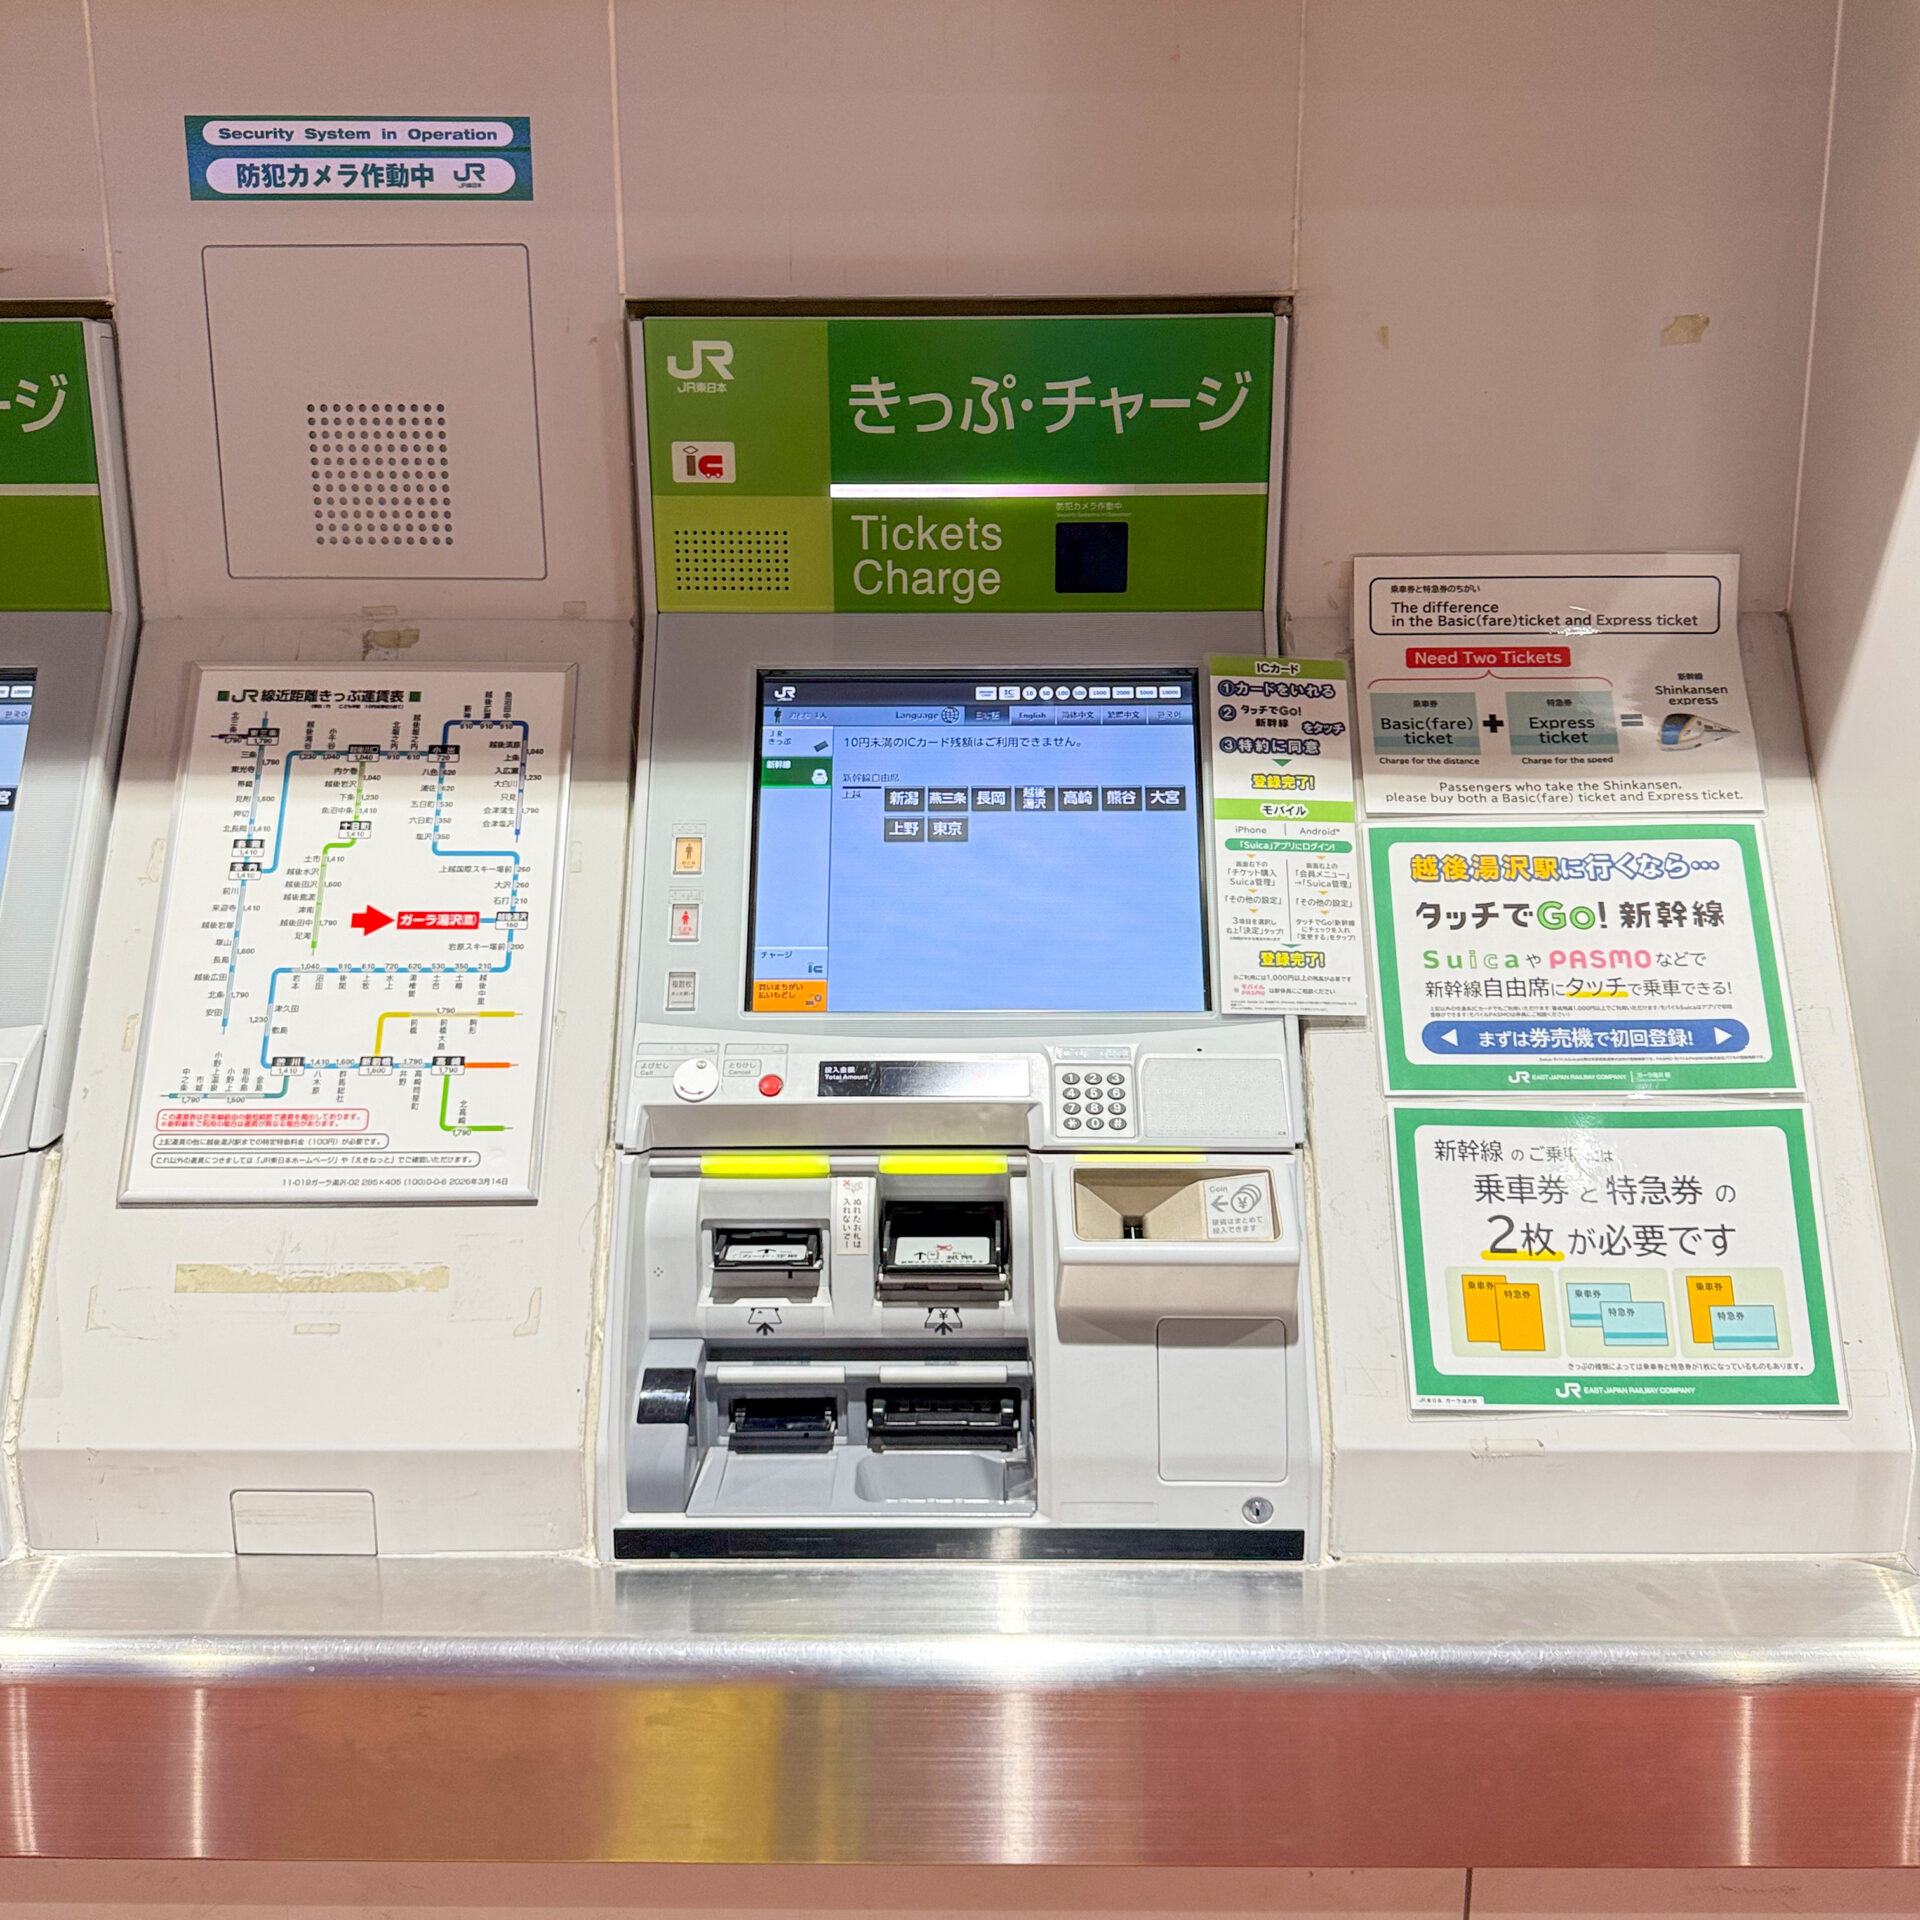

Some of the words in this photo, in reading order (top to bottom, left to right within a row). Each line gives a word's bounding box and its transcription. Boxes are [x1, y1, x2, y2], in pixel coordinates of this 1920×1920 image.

[218, 127, 294, 142] Security
[304, 127, 371, 142] System
[381, 128, 397, 141] in
[407, 127, 498, 142] Operation
[236, 162, 434, 189] 防犯カメラ作動中
[453, 163, 486, 182] JR
[667, 340, 735, 380] JR
[677, 380, 728, 393] JR東日本
[0, 373, 68, 433] ジ
[848, 371, 1253, 436] きっぷ・チャージ
[851, 515, 1003, 551] Tickets
[852, 559, 1002, 604] Charge
[1390, 584, 1481, 594] 乗車券と特急券のちがい
[1391, 602, 1418, 614] The
[1423, 601, 1499, 614] difference
[1391, 615, 1405, 627] in
[1409, 615, 1433, 627] the
[1438, 614, 1560, 629] Basic(fare)ticket
[1565, 614, 1592, 627] and
[1596, 615, 1652, 629] Express
[1656, 614, 1698, 627] ticket
[1414, 652, 1458, 665] Need
[1462, 652, 1497, 665] Two
[1501, 651, 1562, 664] Tickets
[1256, 663, 1299, 674] ICカード
[1677, 673, 1703, 681] 新幹線
[231, 689, 404, 703] JR線近距離きっぷ運賃表
[774, 686, 796, 699] JR
[1655, 685, 1728, 695] Shinkansen
[1413, 700, 1438, 708] 乗車券
[1547, 699, 1572, 707] 特急券
[1669, 697, 1718, 707] express
[896, 711, 939, 721] Language
[1255, 718, 1288, 728] 新幹線
[1302, 721, 1346, 735] をタッチ
[1380, 716, 1473, 731] Basic(fare)
[1529, 717, 1595, 730] Express
[768, 738, 792, 746] きっぷ
[845, 736, 1082, 749] 10円未満のICカード残額はご利用できません。
[1404, 731, 1453, 745] ticket
[1539, 731, 1588, 744] ticket
[766, 761, 791, 769] 新幹線
[1379, 757, 1411, 766] Charge
[1412, 757, 1426, 765] for
[1428, 757, 1442, 765] the
[1444, 757, 1480, 765] distance
[1522, 756, 1554, 765] Charge
[1556, 756, 1569, 764] for
[1572, 756, 1585, 764] the
[1587, 756, 1614, 765] speed
[1251, 774, 1315, 790] 登録完了!
[1439, 782, 1512, 793] Passengers
[1515, 782, 1542, 792] who
[1545, 781, 1574, 792] take
[1578, 781, 1599, 791] the
[890, 792, 919, 806] 新潟
[929, 791, 966, 805] 燕三条
[976, 791, 1006, 806] 長岡
[1063, 791, 1093, 806] 高崎
[1106, 791, 1136, 806] 熊谷
[1150, 790, 1180, 805] 大宮
[1386, 793, 1427, 804] please
[1430, 793, 1454, 804] buy
[1457, 792, 1487, 803] both
[1490, 794, 1499, 802] a
[1502, 791, 1574, 804] Basic(fare)
[1577, 791, 1616, 802] ticket
[1619, 790, 1643, 801] and
[1647, 790, 1698, 801] Express
[1701, 789, 1743, 800] ticket.
[1262, 804, 1306, 816] モバイル
[889, 822, 919, 836] 上野
[933, 822, 962, 835] 東京
[1235, 826, 1267, 834] iPhone
[1416, 901, 1608, 931] タッチでGo!
[1619, 900, 1725, 929] 新幹線
[760, 950, 793, 959] チャージ
[1259, 951, 1326, 968] 登録完了!
[1424, 976, 1733, 998] 新幹線自由席にタッチで乗車できる!
[1478, 1027, 1695, 1049] まずは券売機で初回登録!
[729, 1061, 756, 1069] とりけし
[1508, 1071, 1530, 1083] JR
[1434, 1139, 1504, 1163] 新幹線
[1473, 1174, 1569, 1205] 乗車券
[1580, 1186, 1599, 1204] と
[1606, 1174, 1703, 1205] 特急券
[1715, 1184, 1737, 1204] の
[852, 1198, 862, 1248] ぬれたお札は
[1488, 1214, 1555, 1257] 2枚
[1568, 1223, 1737, 1257] が必要です
[1467, 1282, 1494, 1291] 乗車券
[1695, 1282, 1723, 1292] 乗車券
[1503, 1290, 1531, 1299] 特急券
[1574, 1289, 1601, 1298] 乗車券
[1608, 1308, 1635, 1317] 特急券
[1717, 1312, 1744, 1321] 特急券
[1555, 1383, 1581, 1399] JR
[1605, 1387, 1628, 1395] JAPAN
